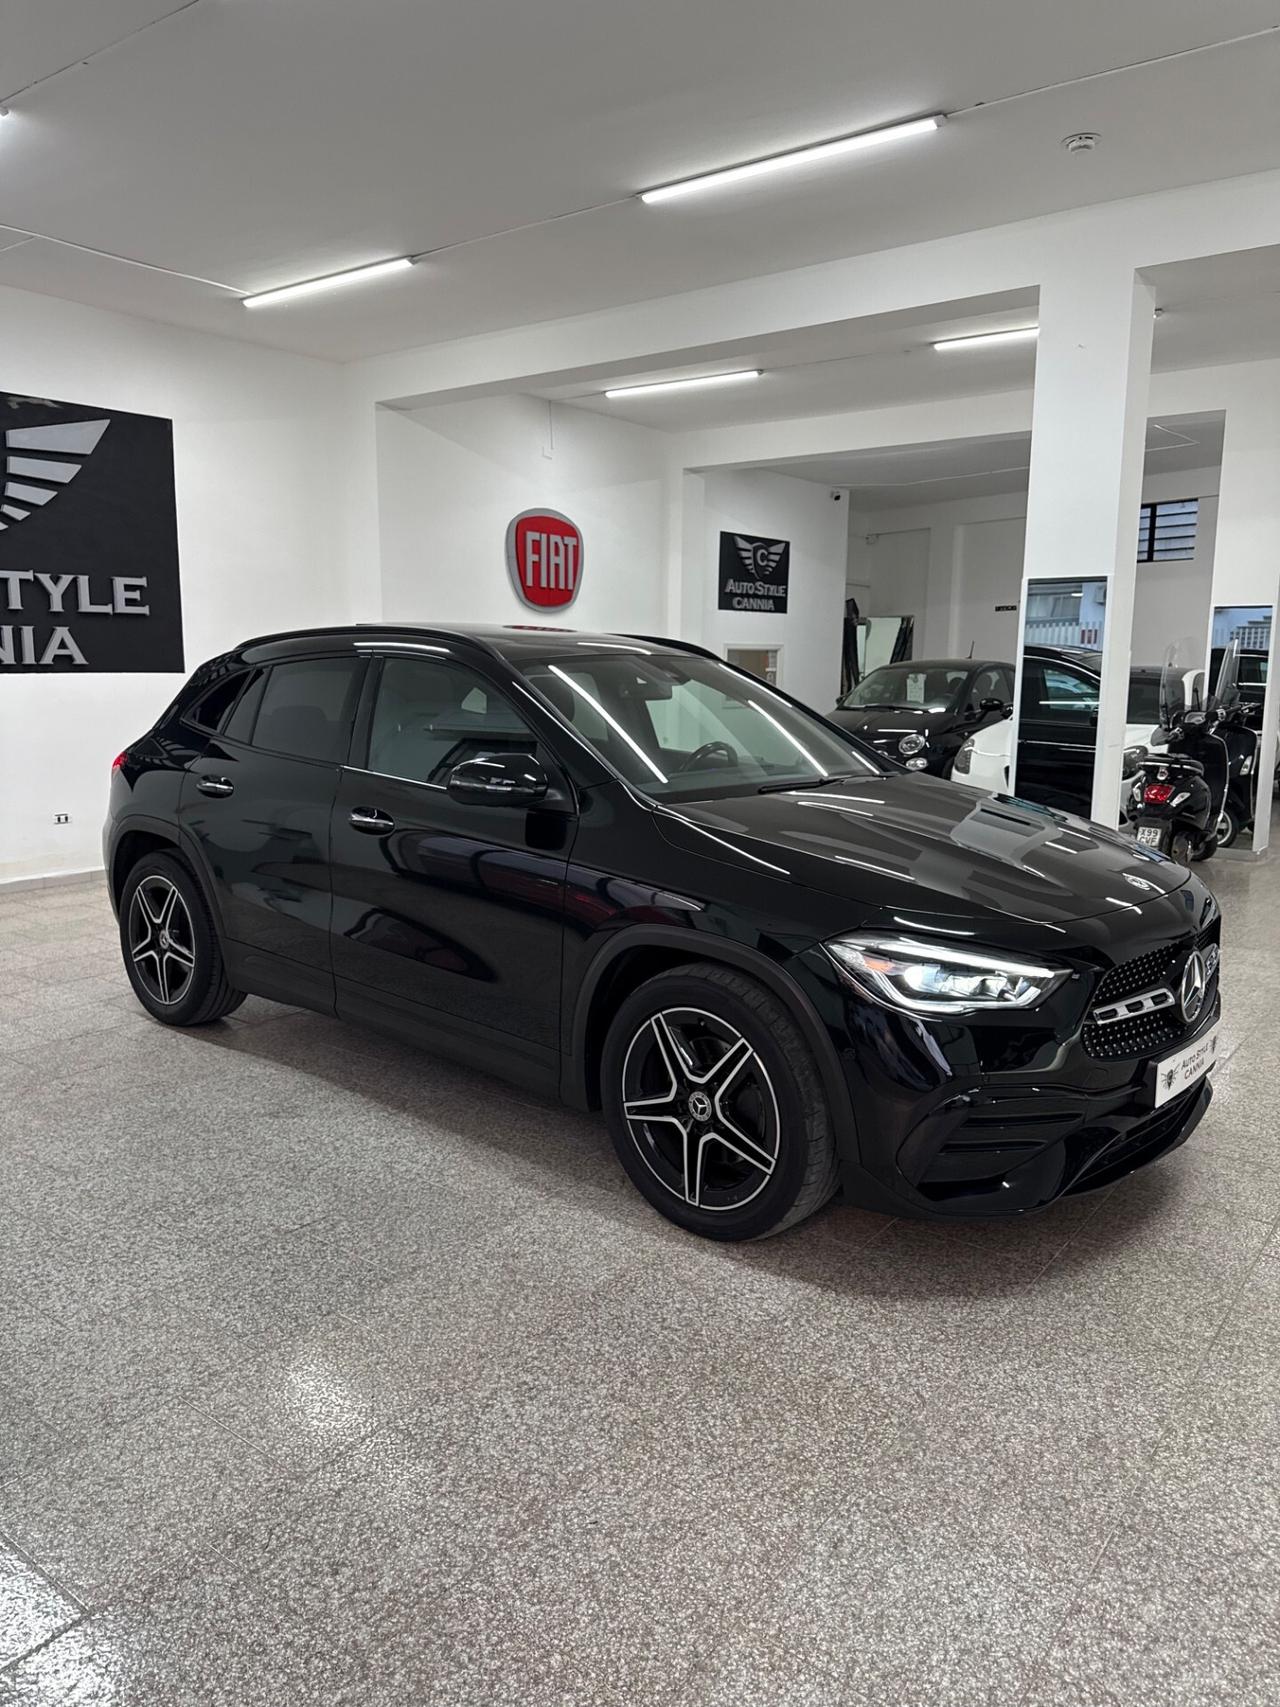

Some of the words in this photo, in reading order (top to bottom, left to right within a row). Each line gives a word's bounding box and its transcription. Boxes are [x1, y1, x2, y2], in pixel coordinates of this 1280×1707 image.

[526, 531, 577, 590] FIAT
[757, 549, 768, 566] C
[732, 597, 775, 611] CANNIA
